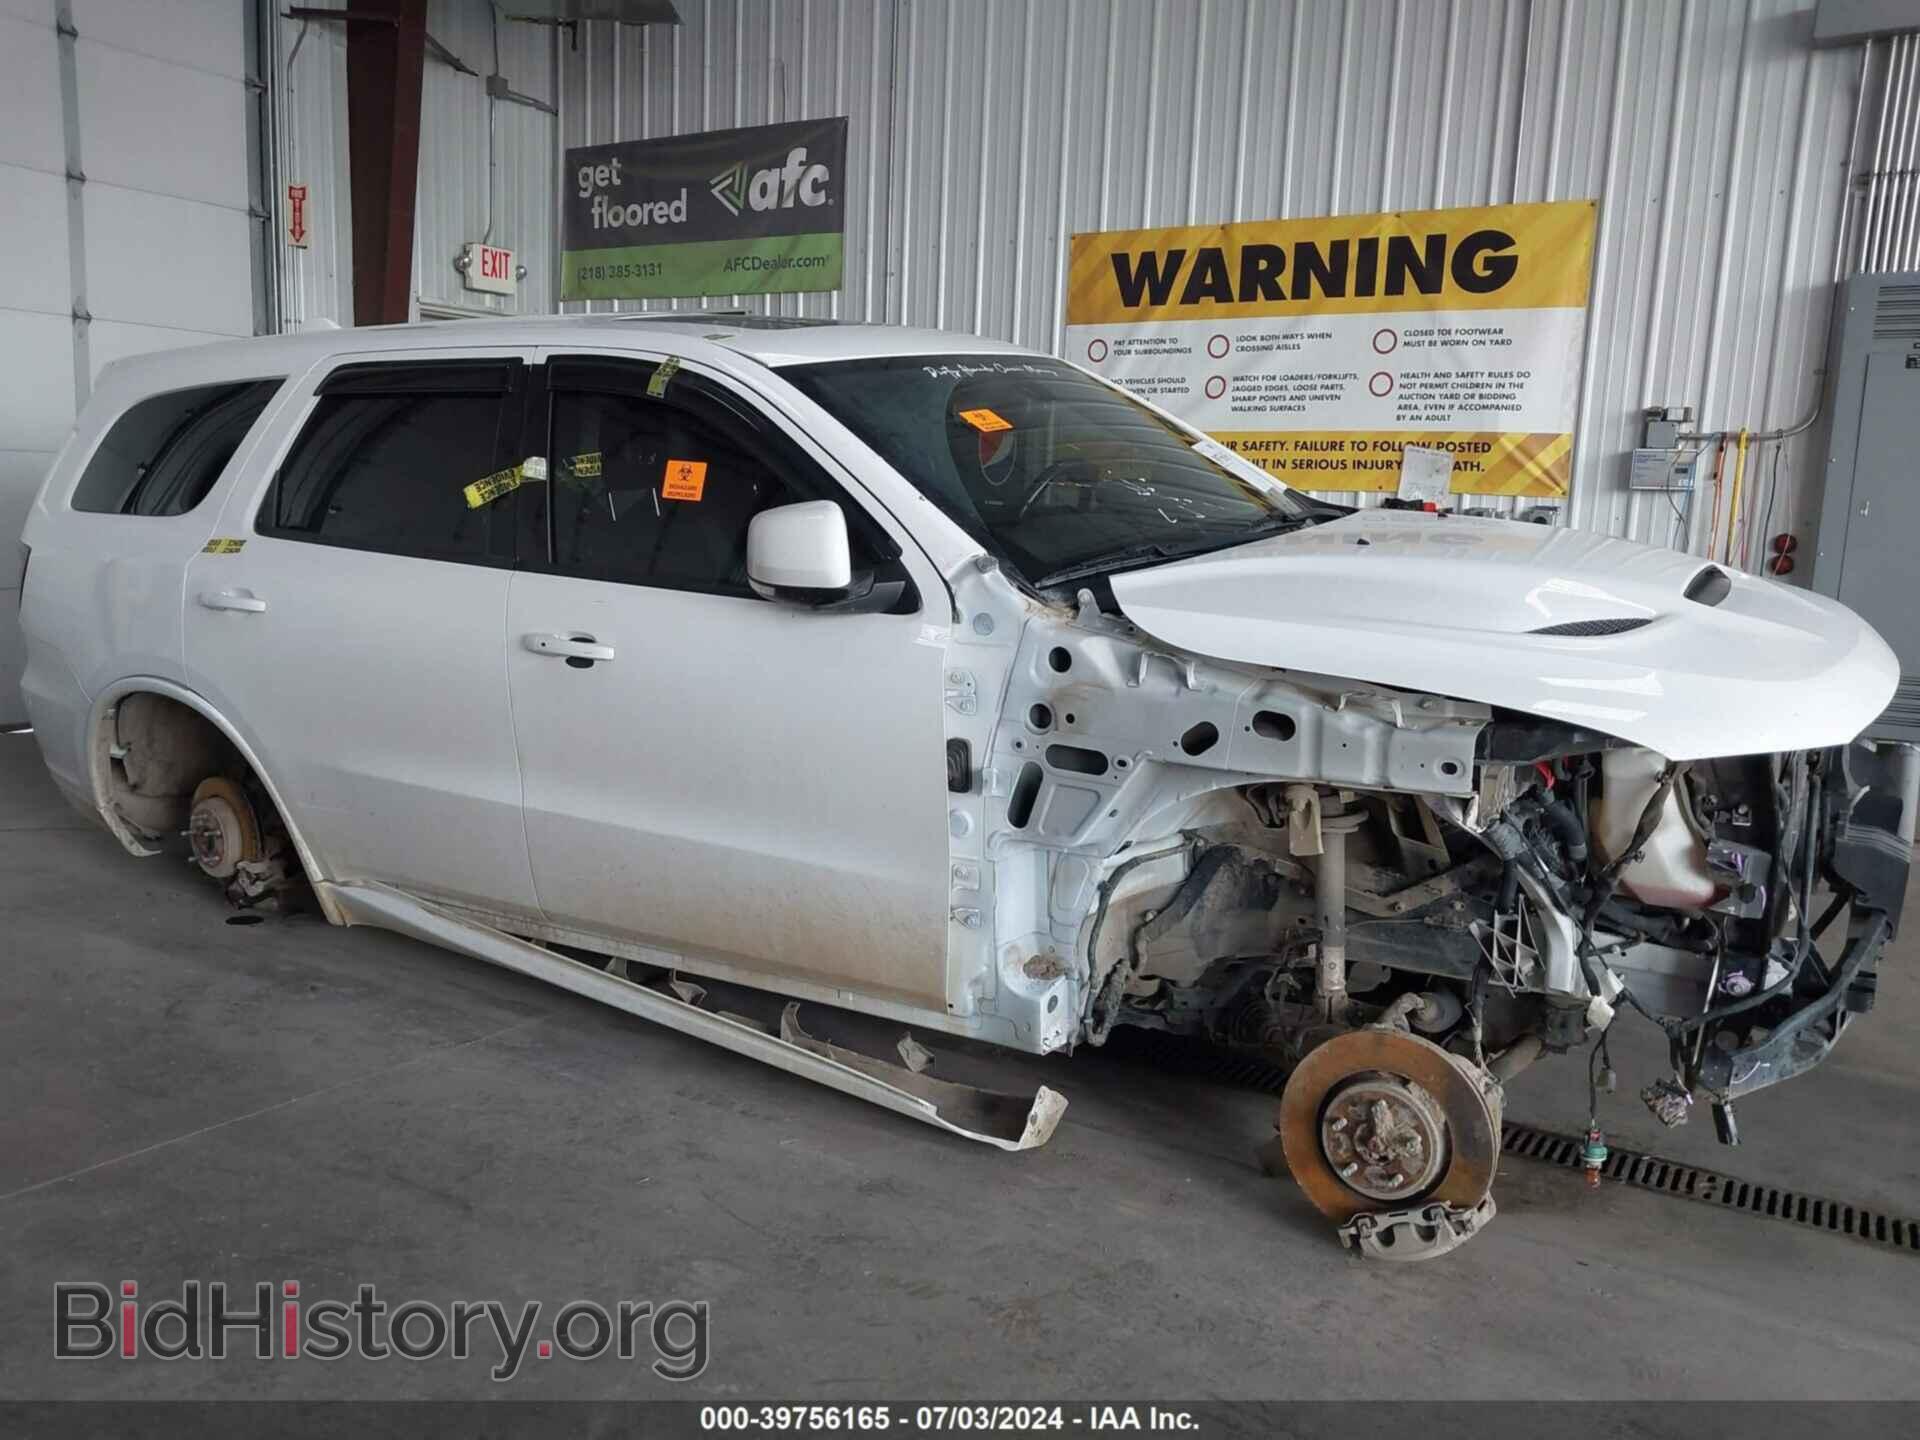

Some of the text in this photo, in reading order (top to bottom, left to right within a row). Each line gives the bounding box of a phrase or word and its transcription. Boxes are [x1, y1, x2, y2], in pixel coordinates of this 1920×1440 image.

[578, 157, 621, 198] get
[750, 148, 829, 212] afc
[592, 188, 687, 229] floored
[482, 249, 511, 280] EXIT
[577, 262, 663, 281] (218) 385-3131
[723, 255, 826, 273] AFCDealer.com
[1111, 229, 1519, 307] WARNING
[1135, 347, 1192, 355] SURROUNDINGS
[1243, 441, 1288, 451] SAFETY.
[1294, 441, 1344, 452] FAILURE
[1350, 441, 1368, 452] TO
[1436, 442, 1492, 454] POSTED
[1273, 459, 1287, 470] IN
[1292, 459, 1347, 470] SERIOUS
[1352, 459, 1401, 470] INJURY
[1453, 461, 1485, 472] ATH.
